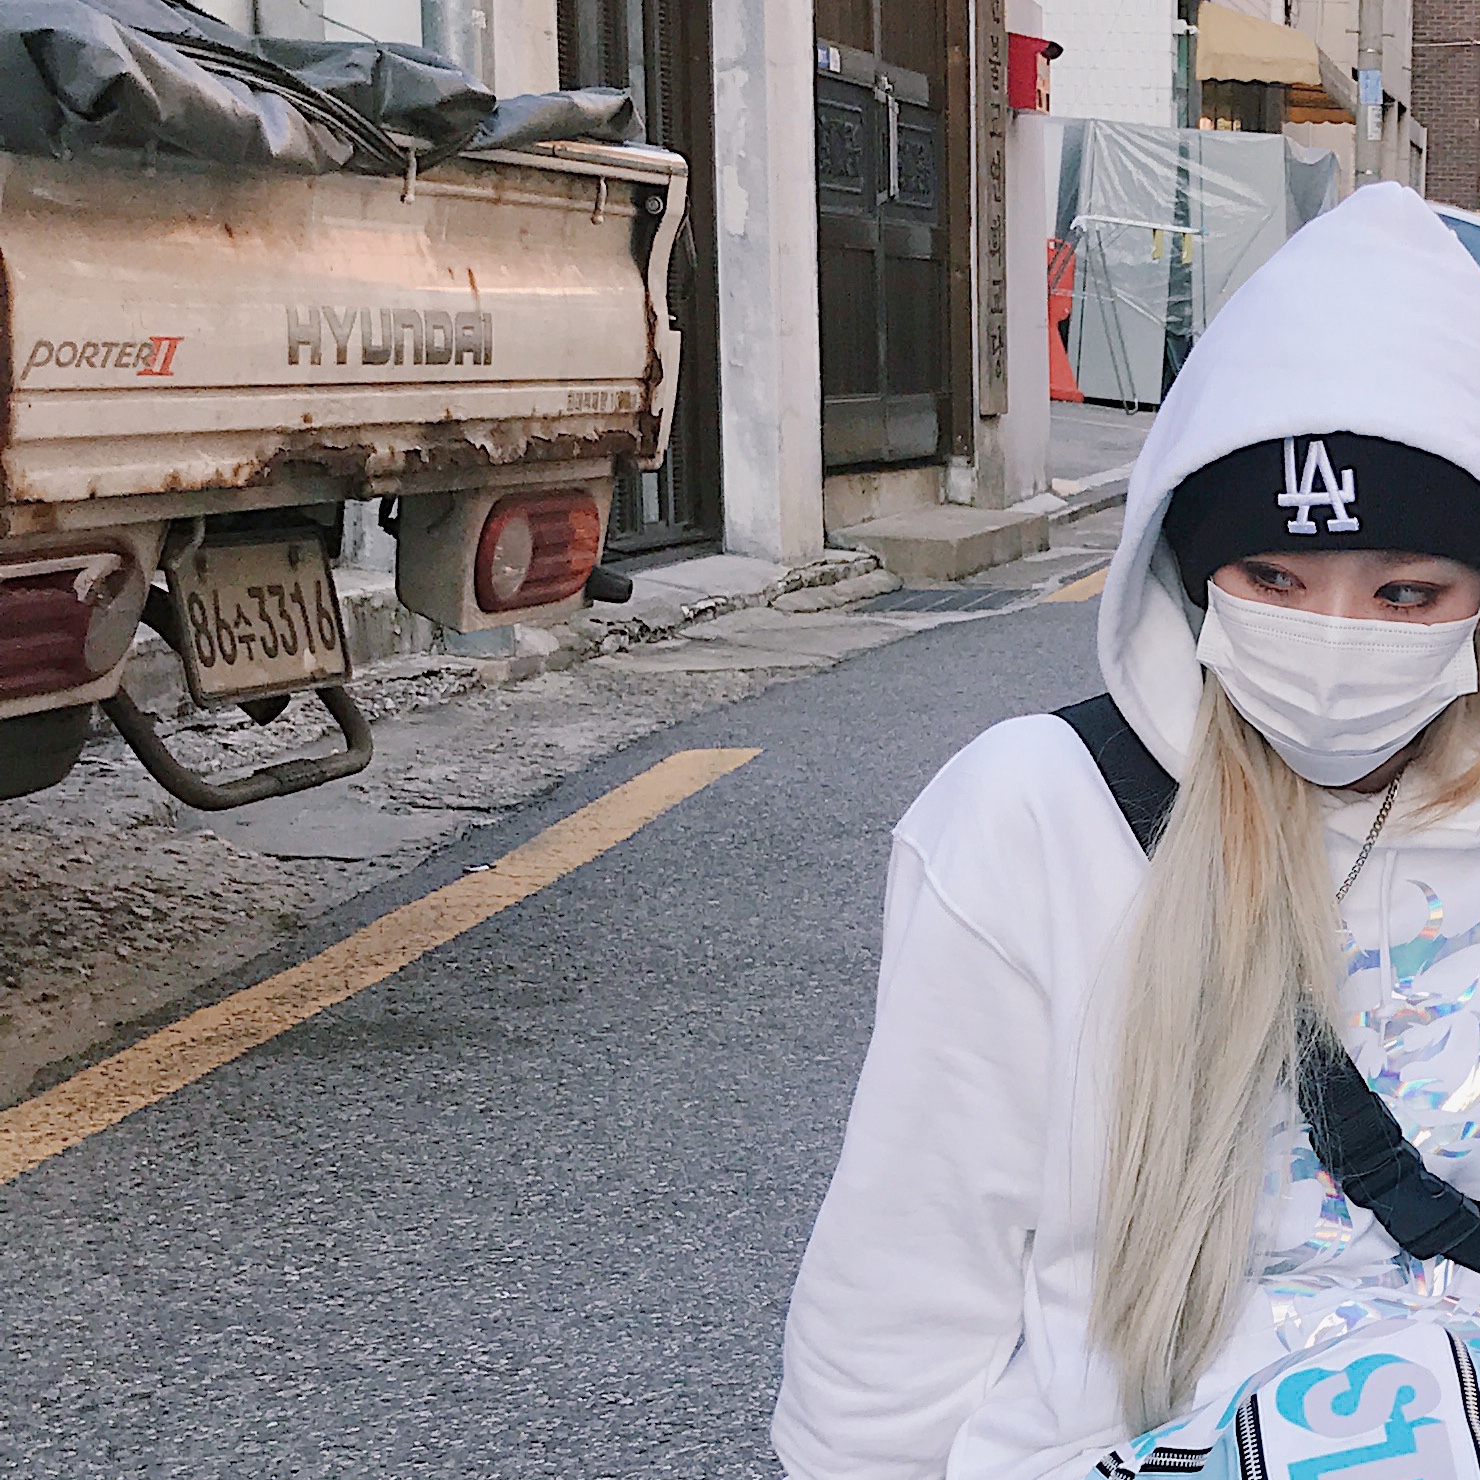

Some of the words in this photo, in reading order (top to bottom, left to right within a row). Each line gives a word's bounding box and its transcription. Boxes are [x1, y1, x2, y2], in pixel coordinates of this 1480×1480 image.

[285, 305, 493, 365] HYUNDAI
[1278, 436, 1360, 534] LA
[187, 579, 336, 668] 86수3316
